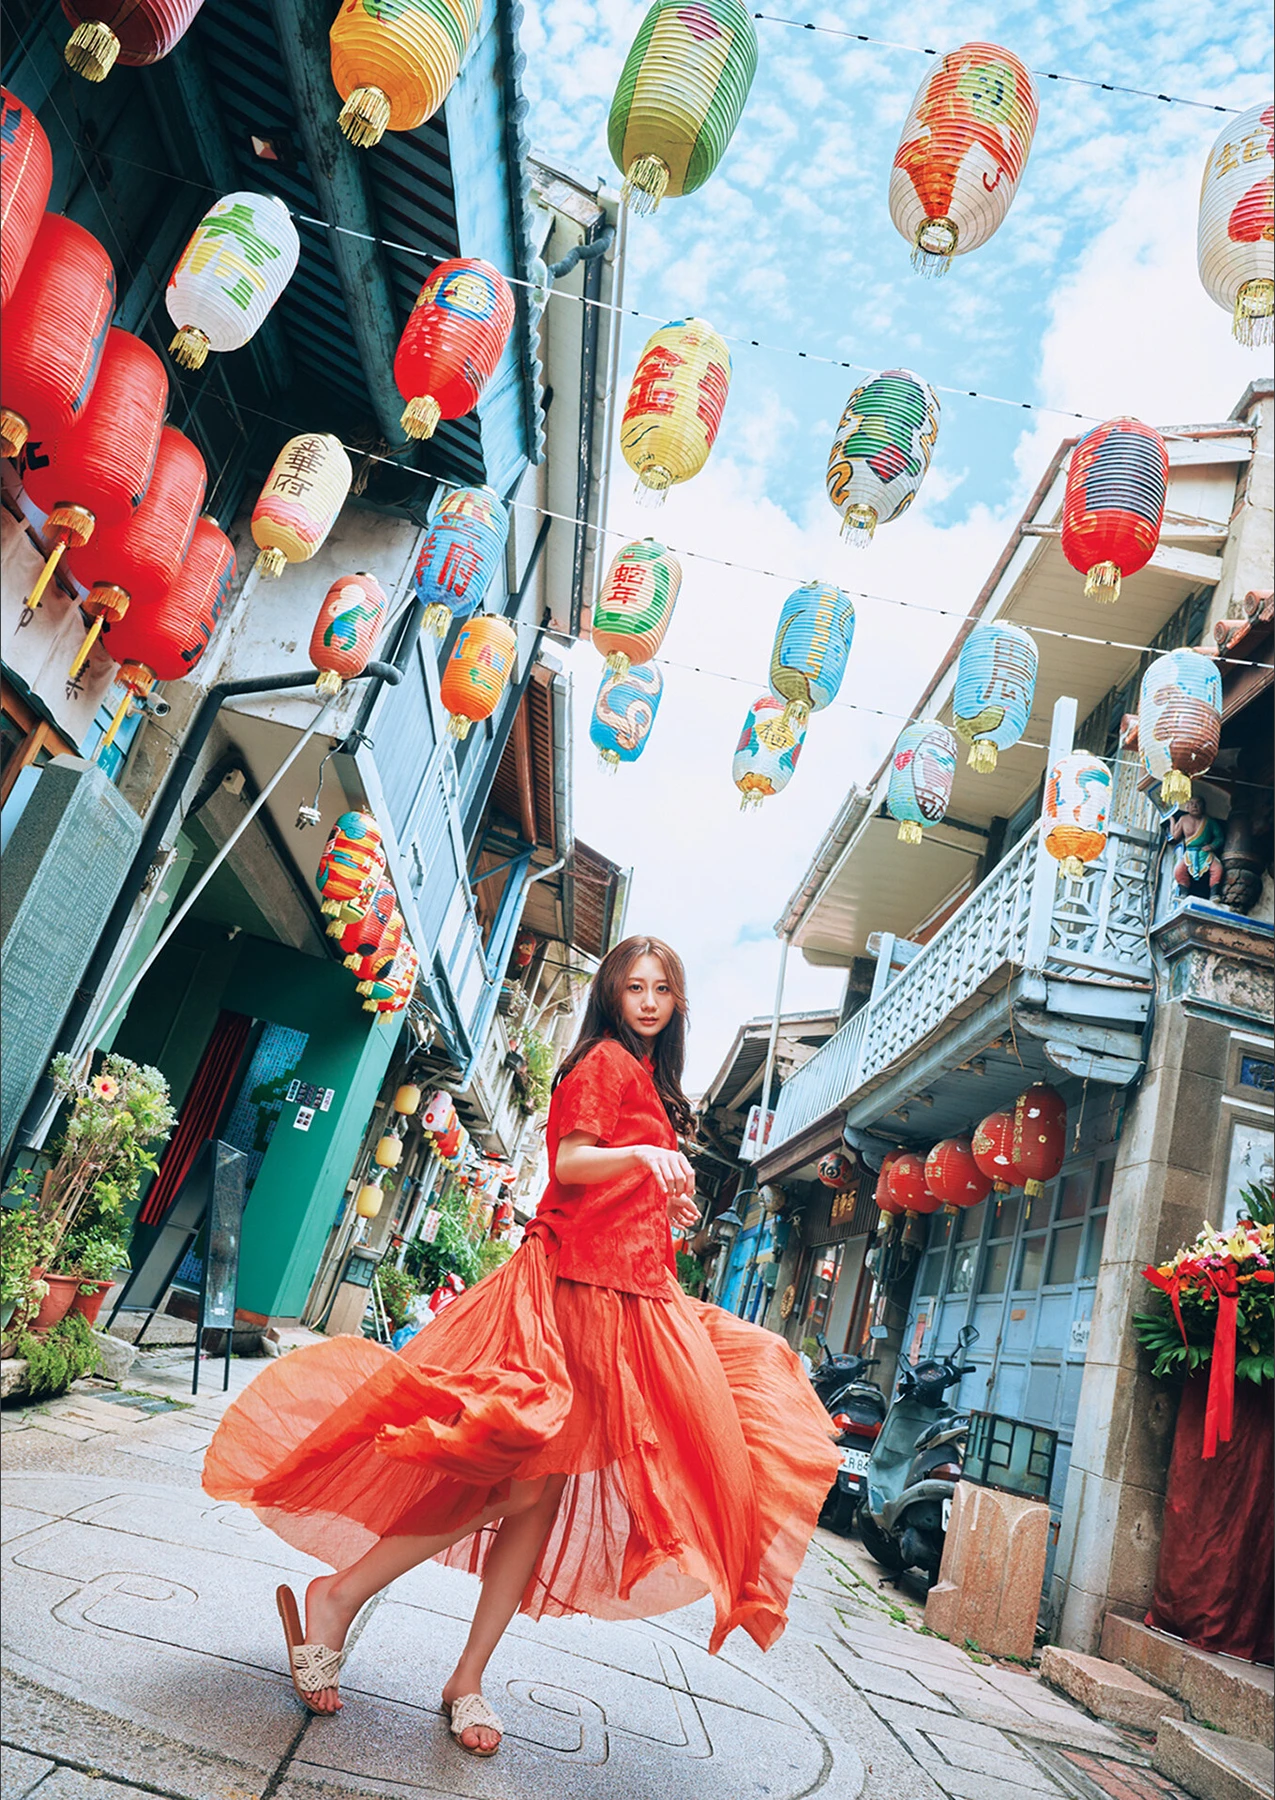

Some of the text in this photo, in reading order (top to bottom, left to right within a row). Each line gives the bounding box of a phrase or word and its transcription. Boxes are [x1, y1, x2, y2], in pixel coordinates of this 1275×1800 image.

[272, 436, 329, 497] 金華府
[607, 563, 647, 605] 蛇年
